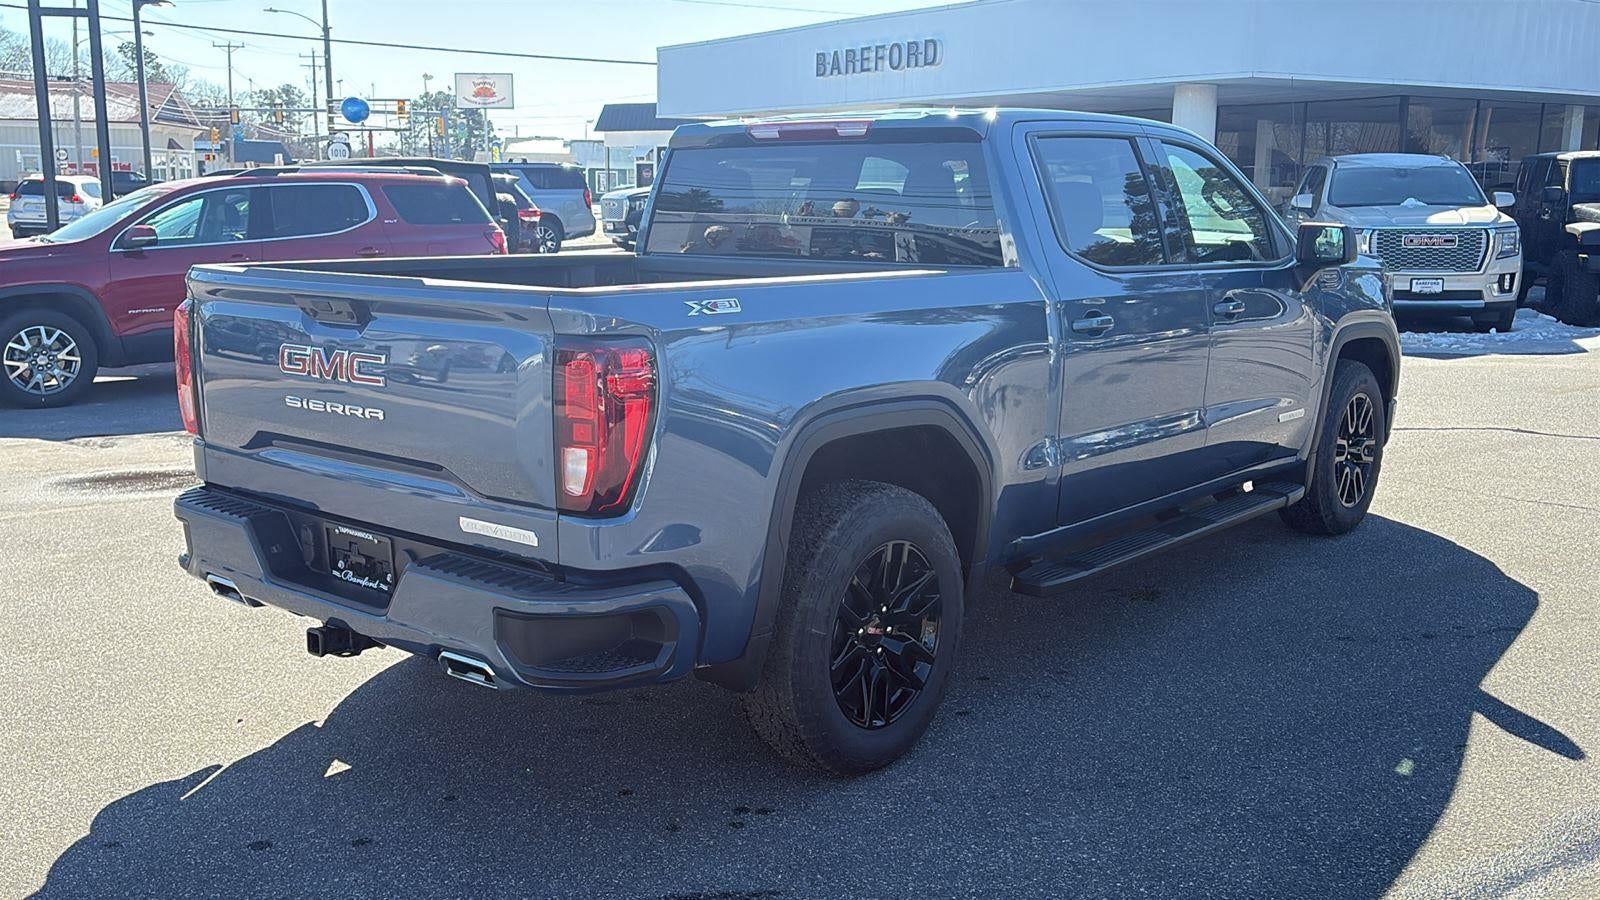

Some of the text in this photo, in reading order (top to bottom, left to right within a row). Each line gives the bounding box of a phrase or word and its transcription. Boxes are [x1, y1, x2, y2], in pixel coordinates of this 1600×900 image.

[815, 38, 941, 78] BAREFORD
[330, 148, 347, 158] 1010
[1404, 235, 1456, 247] GMC
[279, 343, 387, 387] GMC
[285, 395, 385, 421] SIERRA
[341, 569, 380, 589] Bareford
